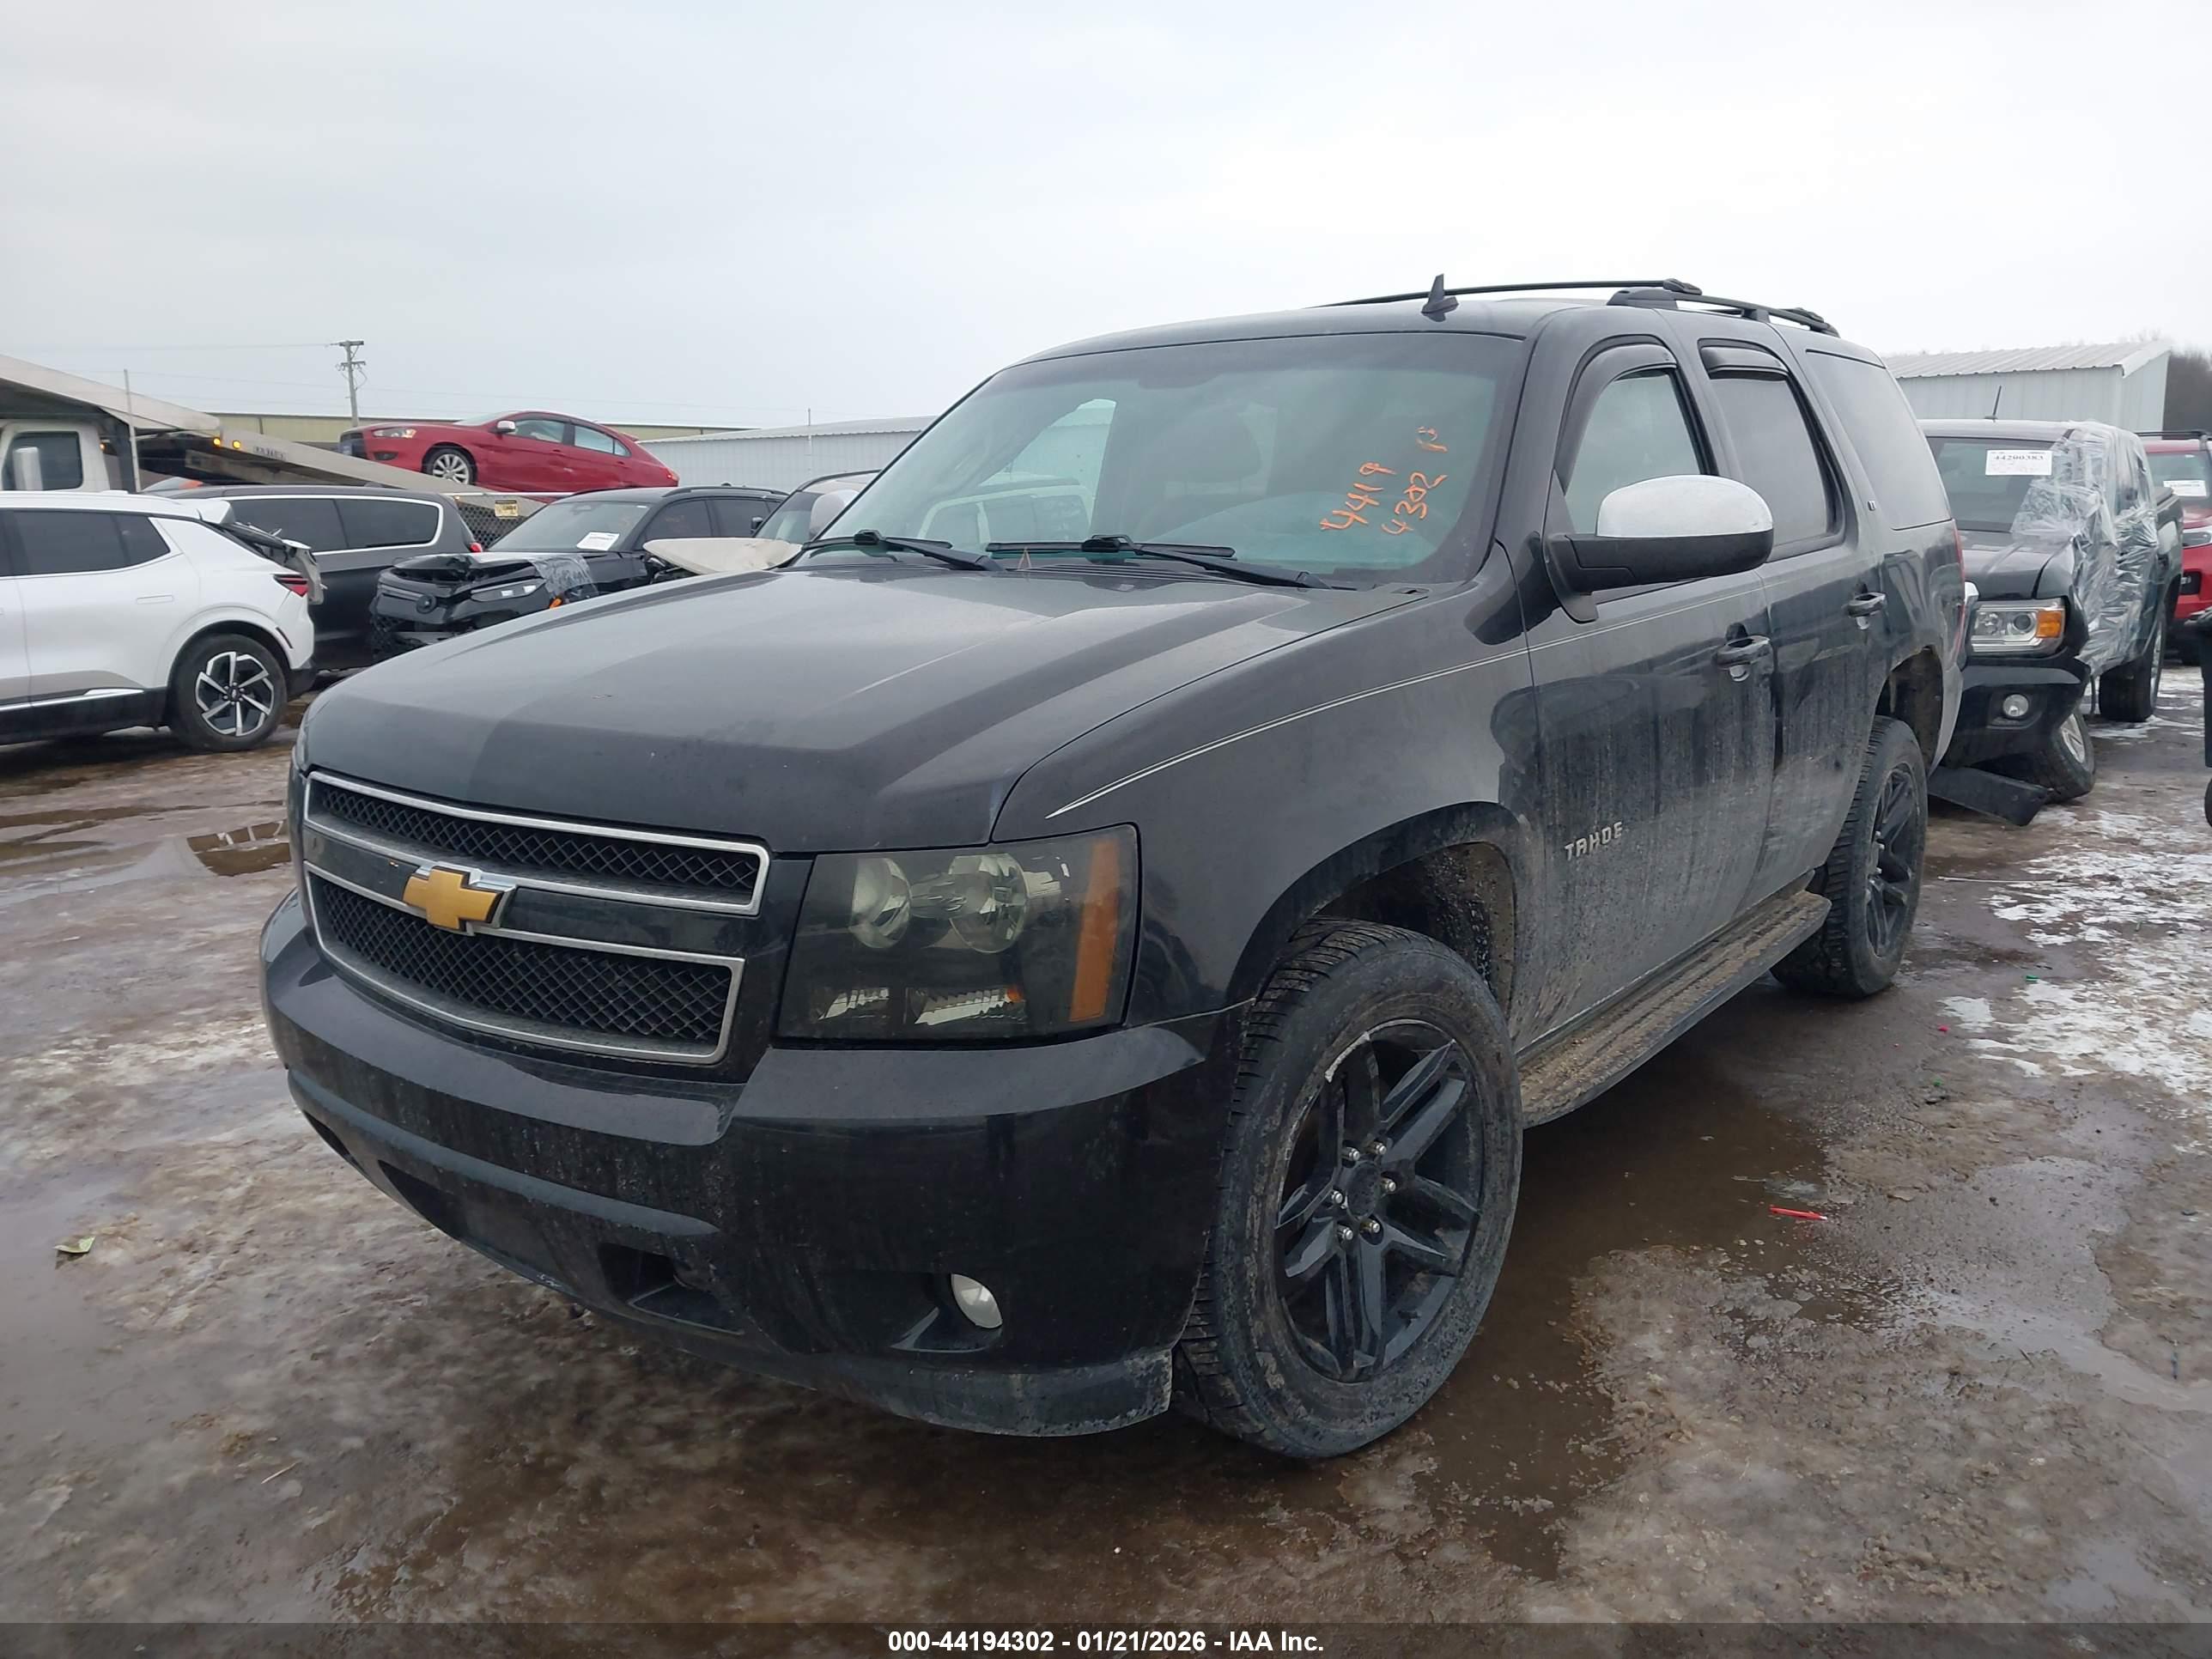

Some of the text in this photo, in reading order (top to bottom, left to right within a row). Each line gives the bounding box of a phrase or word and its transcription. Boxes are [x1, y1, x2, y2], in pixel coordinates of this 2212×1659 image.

[1320, 462, 1397, 530] 4419
[1381, 471, 1448, 535] 4302
[1564, 821, 1623, 861] TAHOE
